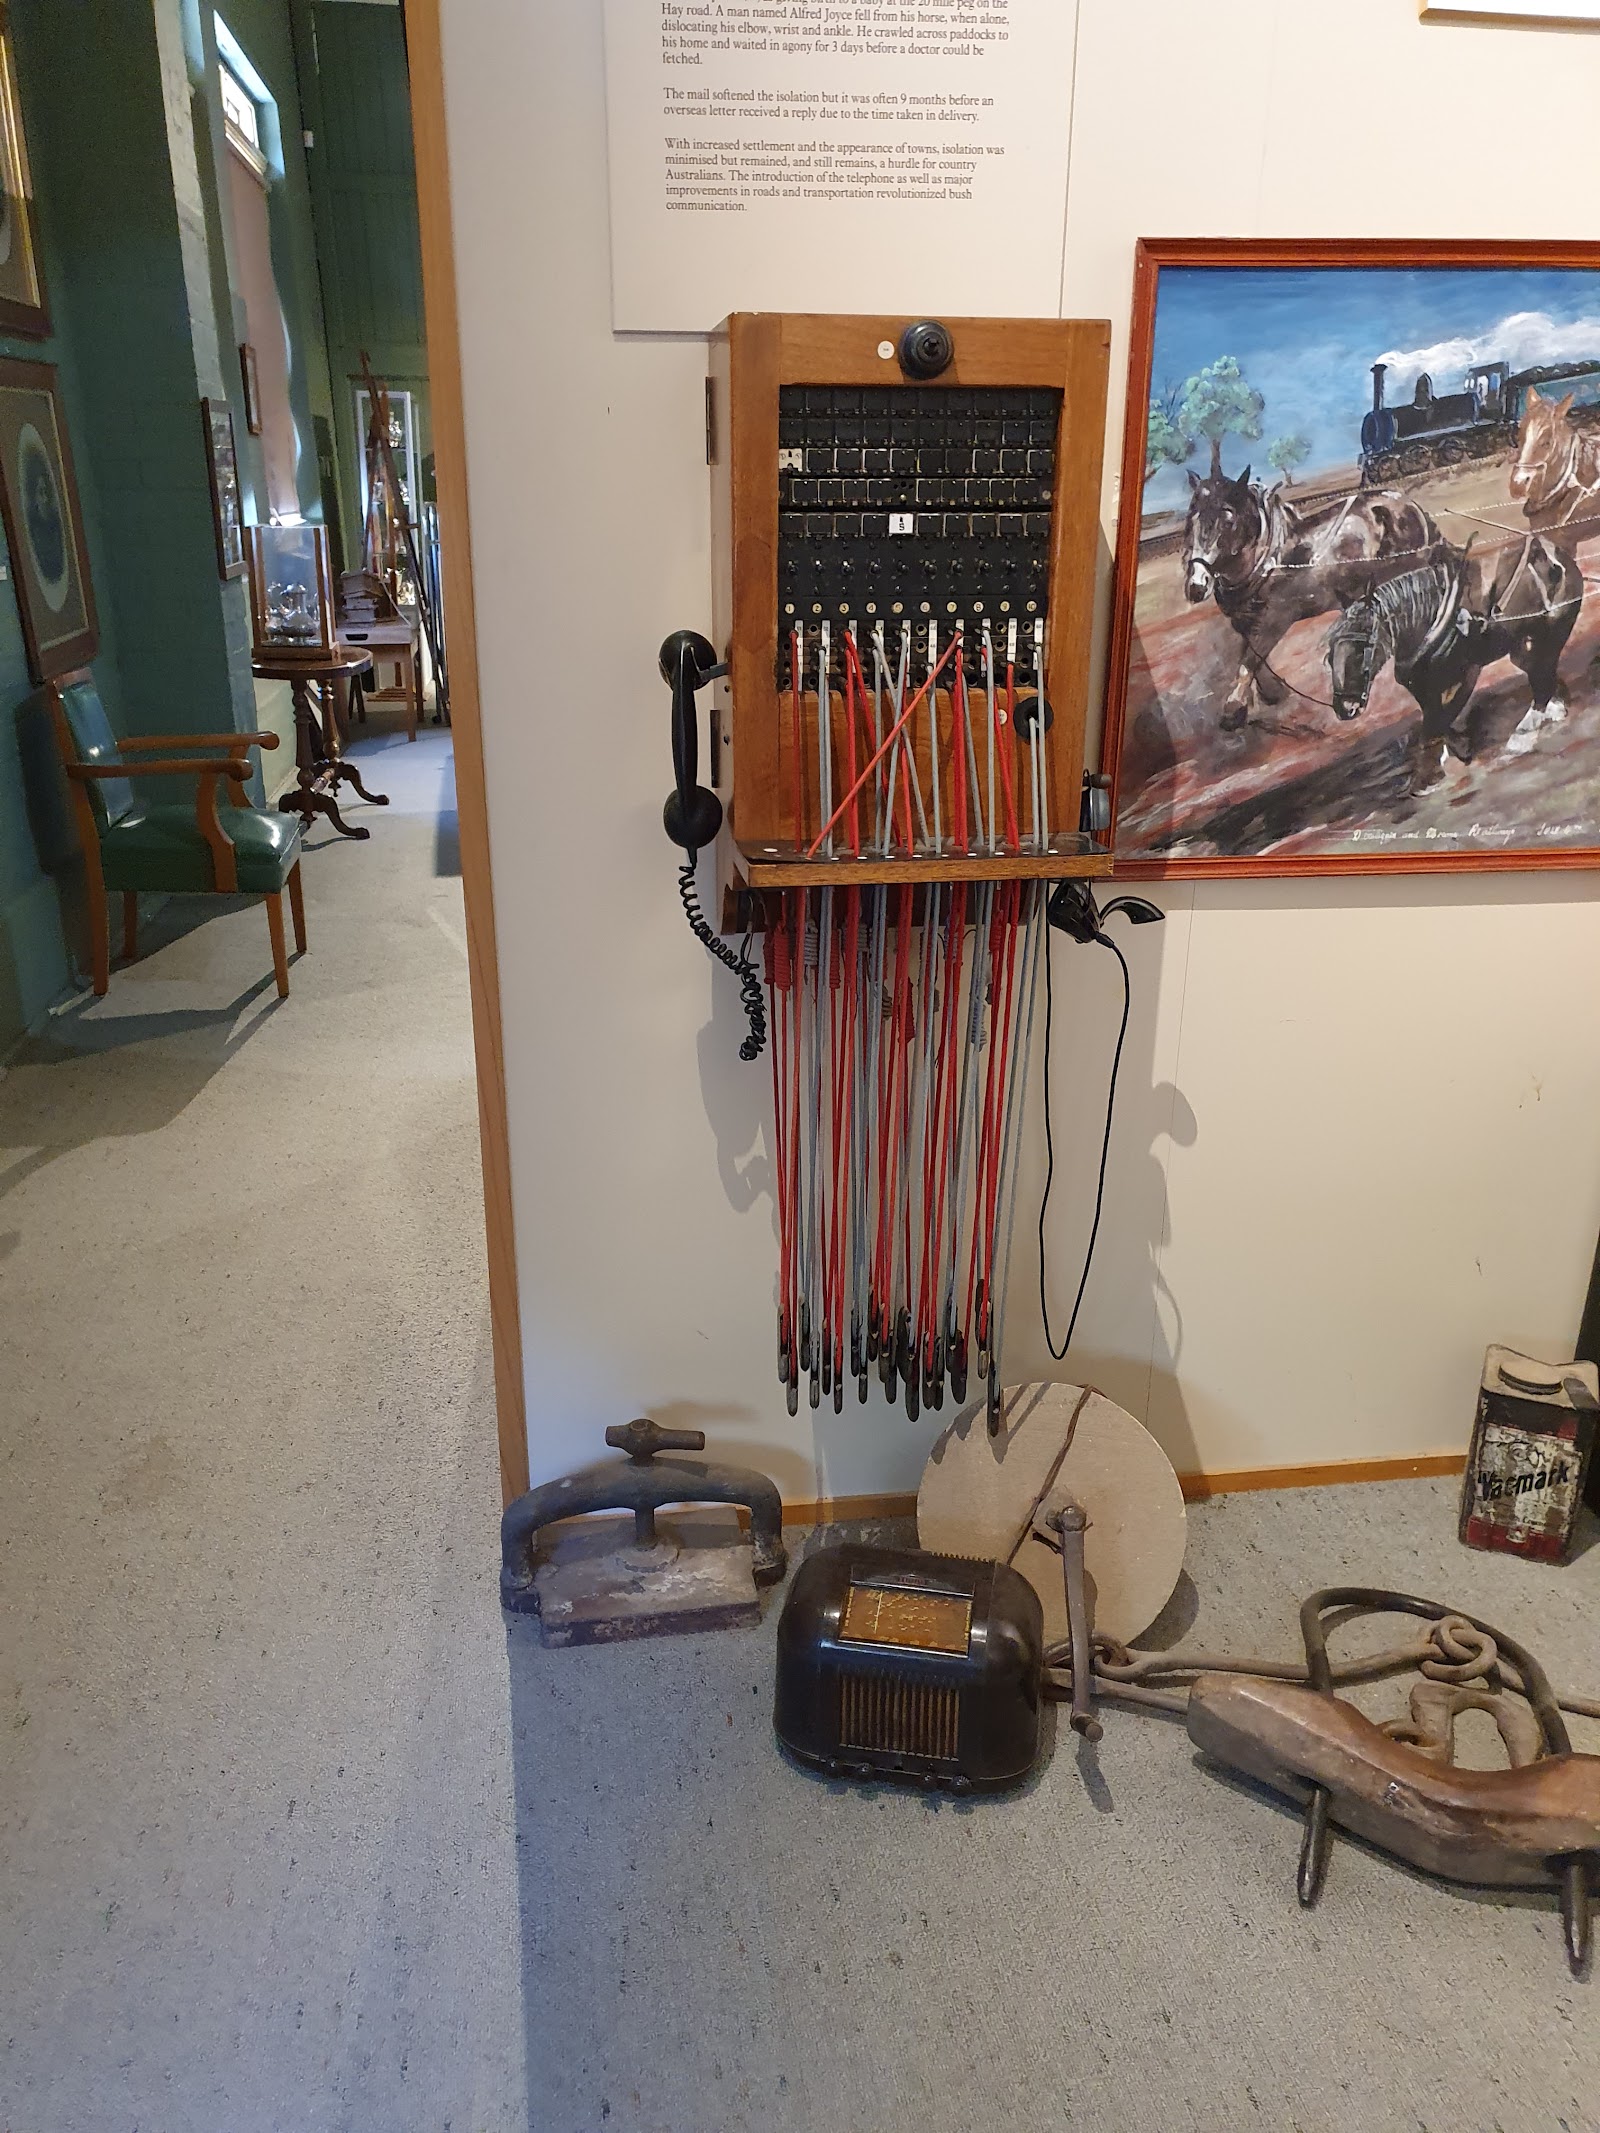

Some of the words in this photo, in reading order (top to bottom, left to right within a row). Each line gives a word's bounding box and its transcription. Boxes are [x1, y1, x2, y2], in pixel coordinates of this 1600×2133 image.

[662, 3, 684, 19] Hay
[686, 4, 713, 16] road.
[715, 5, 724, 16] A
[726, 9, 750, 17] man
[752, 6, 787, 18] named
[789, 7, 822, 19] Alfred
[823, 8, 853, 24] Joyce
[854, 9, 871, 21] fell
[873, 9, 898, 21] from
[900, 10, 915, 22] his
[917, 10, 948, 24] horse,
[950, 11, 978, 24] when
[979, 12, 1010, 26] alone,
[957, 0, 975, 11] peg
[976, 0, 990, 8] on
[992, 0, 1009, 9] the
[661, 20, 718, 36] dislocating
[720, 21, 736, 33] his
[737, 22, 772, 36] elbow,
[773, 24, 800, 35] wrist
[802, 23, 821, 36] and
[823, 24, 854, 36] ankle.
[857, 25, 872, 37] He
[874, 25, 914, 38] crawled
[916, 30, 947, 39] across
[949, 28, 996, 44] paddocks
[998, 30, 1009, 41] to
[662, 36, 678, 48] his
[679, 36, 709, 49] home
[710, 37, 730, 49] and
[732, 38, 767, 50] waited
[769, 40, 780, 50] in
[781, 43, 813, 55] agony
[815, 40, 830, 52] for
[831, 40, 838, 52] 3
[840, 41, 864, 56] days
[865, 41, 898, 54] before
[899, 46, 906, 54] a
[907, 42, 941, 55] doctor
[942, 43, 970, 56] could
[972, 44, 984, 56] be
[662, 52, 703, 66] fetched.
[663, 88, 685, 100] The
[687, 88, 710, 100] mail
[712, 89, 755, 101] softened
[757, 90, 774, 101] the
[776, 90, 820, 103] isolation
[821, 91, 839, 103] but
[841, 92, 849, 103] it
[851, 95, 871, 104] was
[872, 92, 898, 104] often
[900, 93, 907, 104] 9
[909, 93, 947, 105] months
[948, 94, 980, 106] before
[981, 98, 994, 106] an
[663, 107, 707, 116] overseas
[709, 104, 736, 116] letter
[738, 105, 781, 117] received
[783, 109, 789, 117] a
[791, 106, 817, 121] reply
[819, 107, 838, 118] due
[840, 108, 851, 119] to
[853, 107, 869, 119] the
[871, 109, 894, 120] time
[896, 108, 924, 120] taken
[926, 110, 936, 121] in
[938, 109, 979, 125] delivery.
[665, 138, 690, 150] With
[692, 138, 740, 150] increased
[742, 139, 795, 151] settlement
[797, 140, 817, 152] and
[818, 140, 835, 152] the
[837, 144, 893, 157] appearance
[895, 142, 905, 153] of
[907, 143, 940, 156] towns,
[942, 143, 984, 155] isolation
[986, 147, 1005, 155] was
[665, 153, 718, 165] minimised
[720, 154, 738, 166] but
[740, 154, 791, 168] remained,
[792, 155, 812, 167] and
[813, 156, 833, 167] still
[834, 157, 878, 170] remains,
[879, 160, 886, 168] a
[888, 157, 920, 169] hurdle
[922, 157, 937, 169] for
[938, 159, 977, 173] country
[665, 168, 725, 180] Australians.
[729, 169, 750, 181] The
[751, 170, 814, 182] introduction
[816, 171, 827, 182] of
[828, 171, 845, 183] the
[846, 171, 895, 187] telephone
[909, 172, 930, 184] well
[931, 176, 942, 184] as
[944, 176, 973, 188] major
[666, 185, 738, 199] improvements
[740, 186, 750, 196] in
[753, 185, 780, 197] roads
[782, 185, 801, 197] and
[803, 187, 874, 202] transportation
[876, 187, 947, 199] revolutionized
[948, 188, 972, 199] bush
[665, 199, 749, 210] communication.
